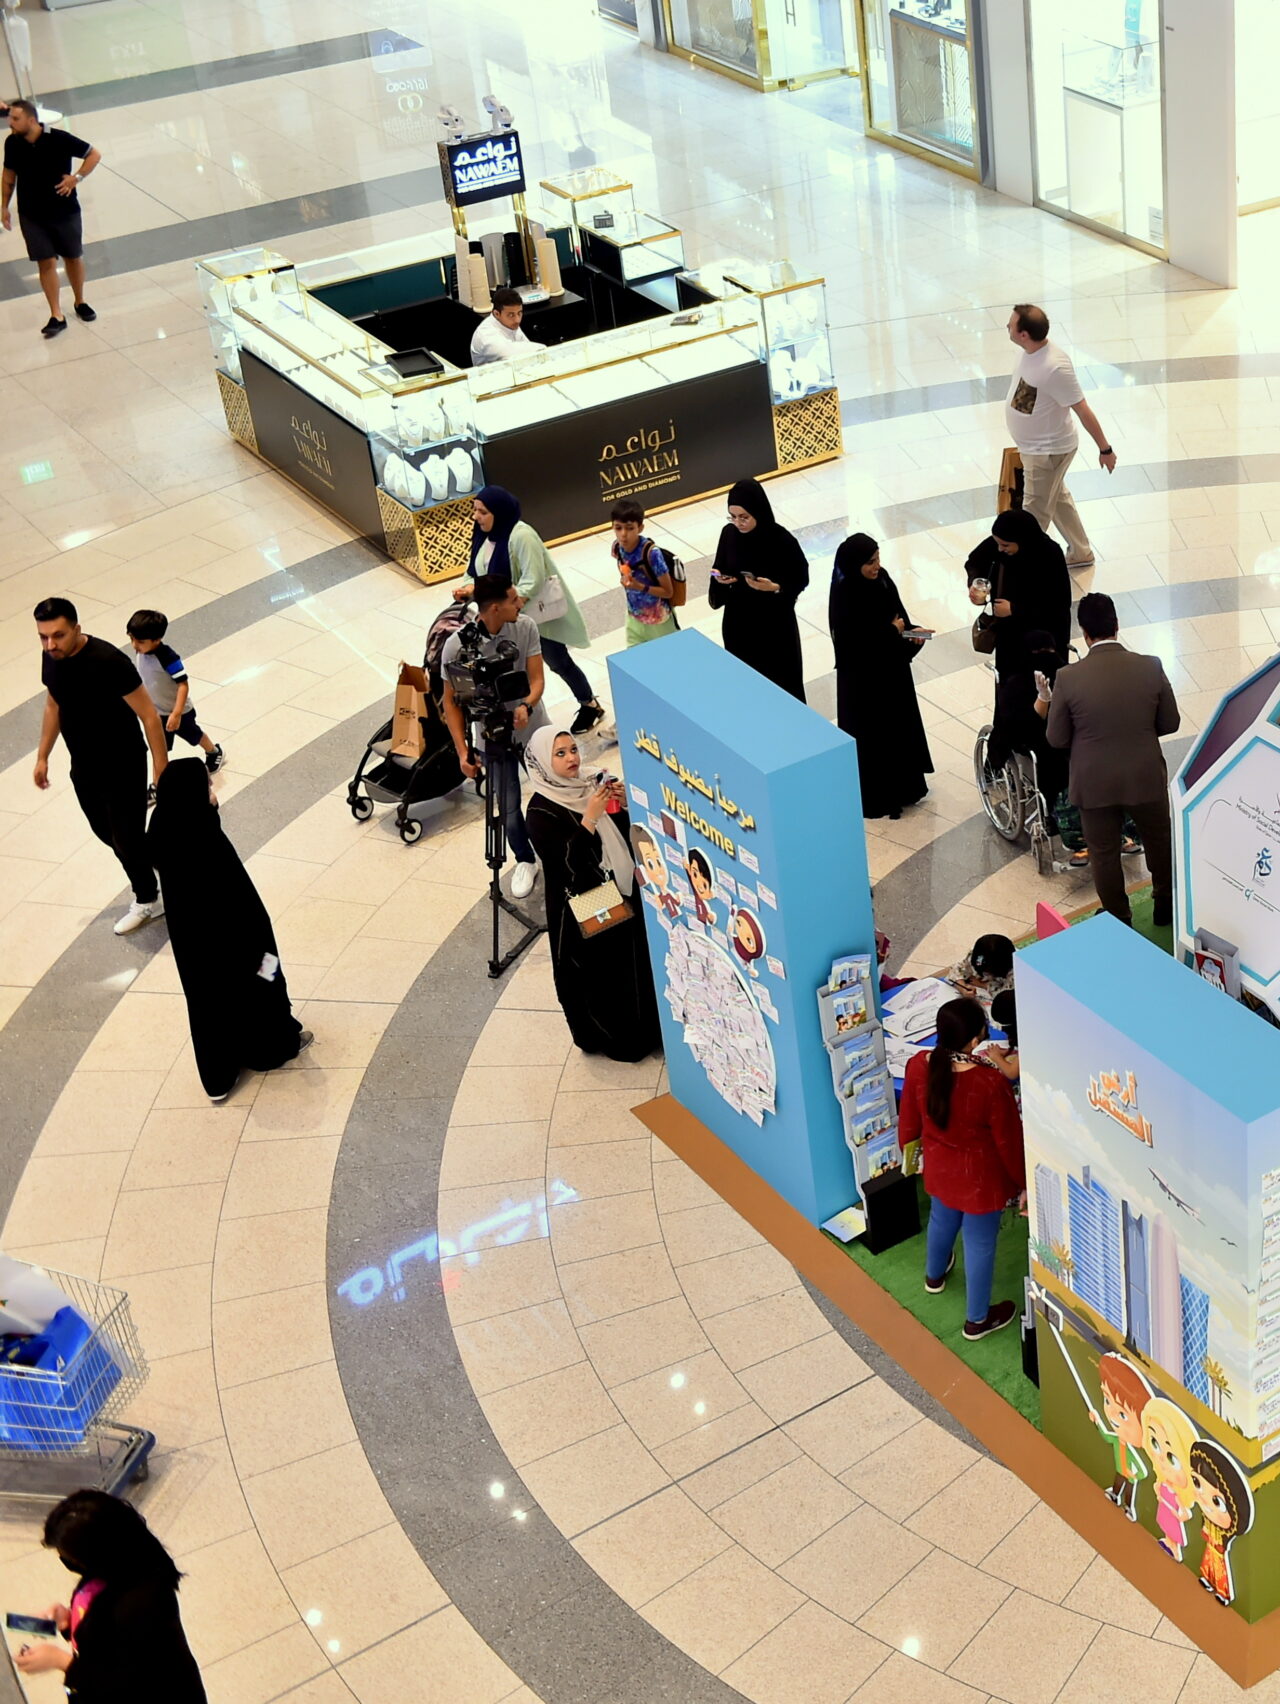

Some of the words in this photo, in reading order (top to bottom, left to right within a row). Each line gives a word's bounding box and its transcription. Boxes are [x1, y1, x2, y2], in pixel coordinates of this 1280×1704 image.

[453, 136, 517, 166] نواعم
[454, 156, 520, 184] NAWAEM
[598, 418, 676, 462] نواعم
[599, 448, 680, 489] NAWAEM
[602, 494, 615, 503] FOR
[616, 488, 633, 498] GOLD
[634, 484, 648, 494] AND
[648, 474, 681, 489] DIAMONDS
[633, 727, 662, 761] قطر
[660, 781, 736, 858] Welcome
[1255, 817, 1269, 828] Social
[1086, 1074, 1153, 1148] المستقبل
